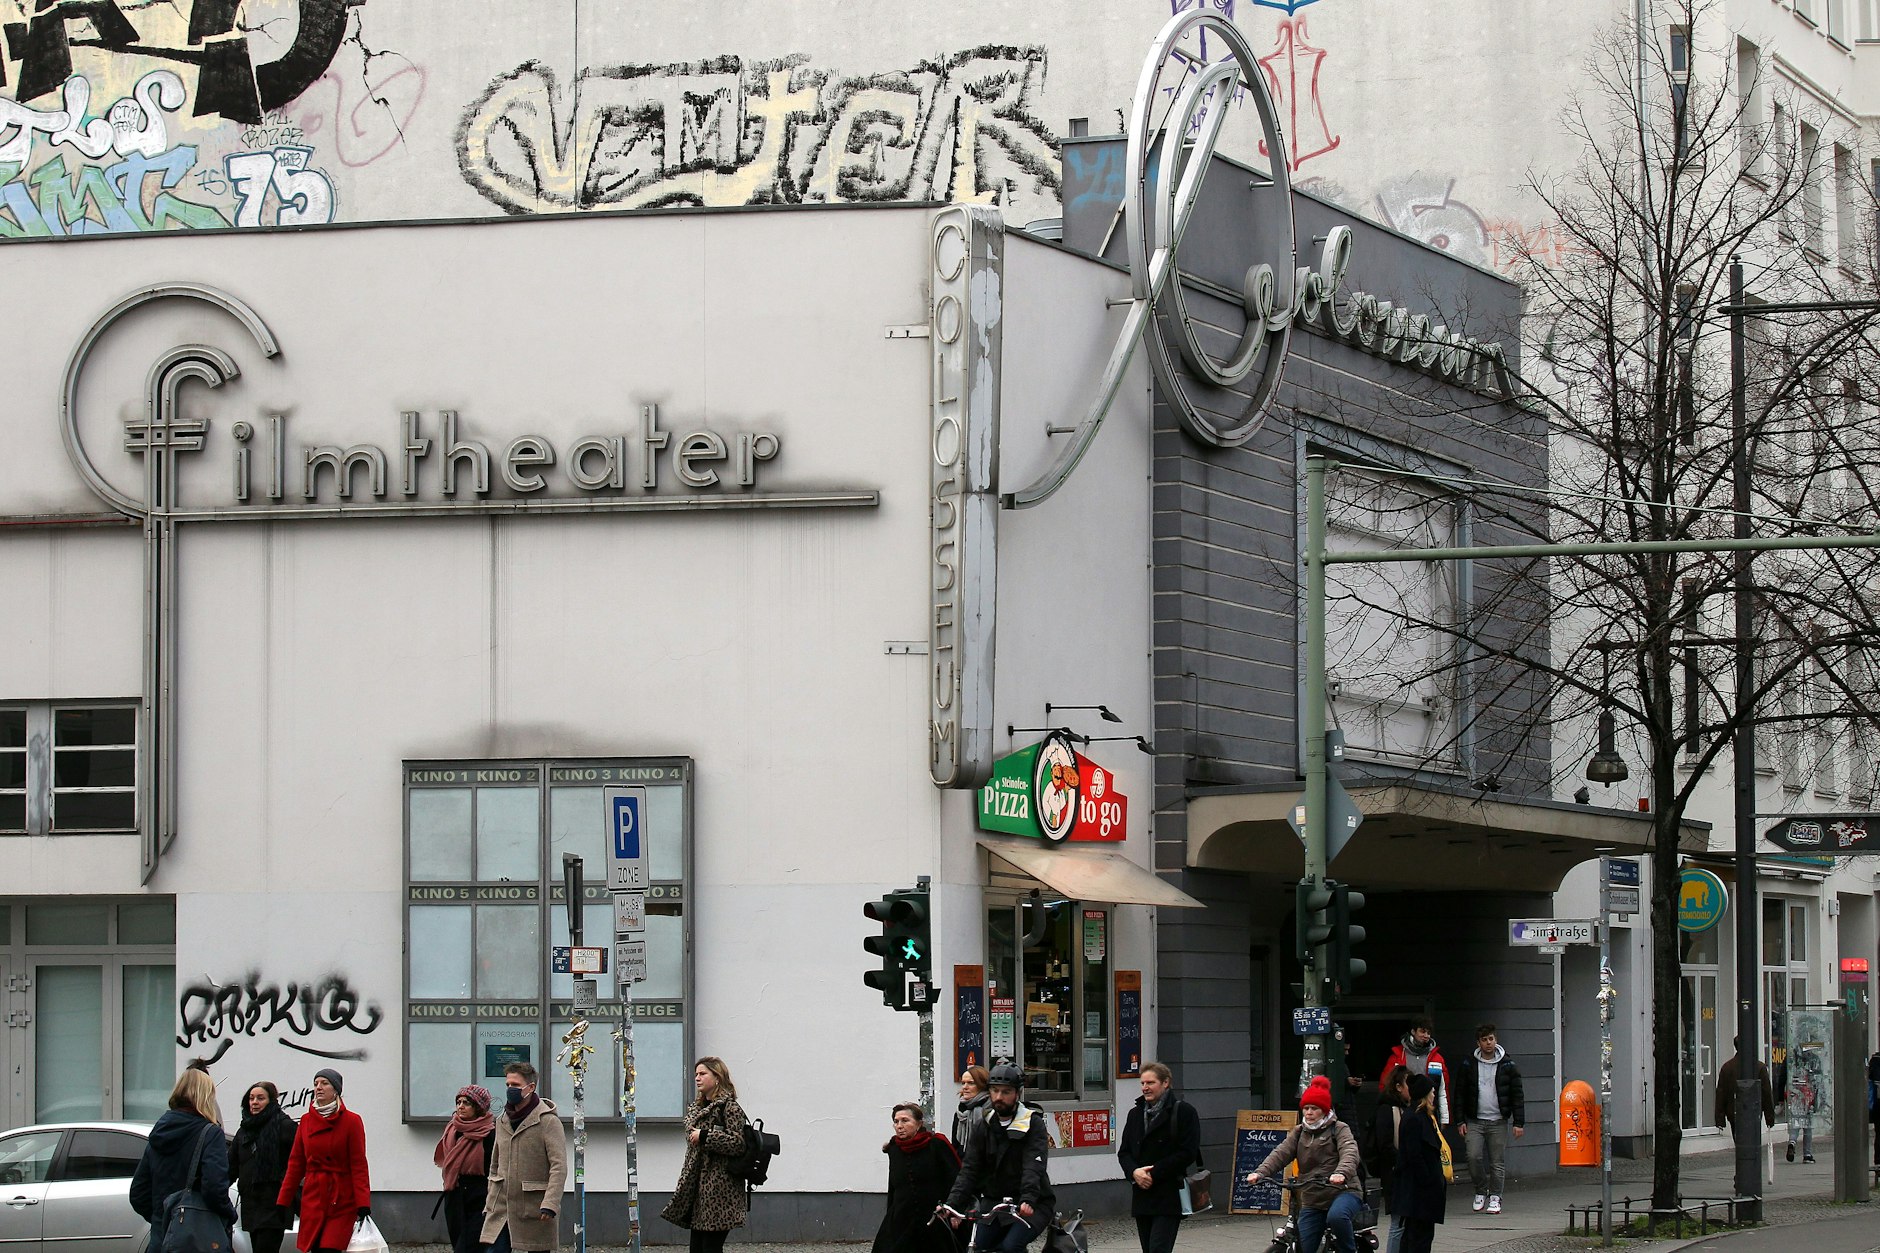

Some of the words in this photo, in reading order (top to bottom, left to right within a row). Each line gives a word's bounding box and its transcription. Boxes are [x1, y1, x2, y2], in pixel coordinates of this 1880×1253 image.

[932, 223, 967, 765] COLOSSEUM
[411, 770, 455, 782] KINO
[461, 771, 468, 781] 1
[477, 770, 521, 782] KINO
[526, 771, 536, 781] 2
[552, 769, 597, 780] KINO
[602, 769, 611, 780] 3
[620, 768, 664, 779] KINO
[670, 768, 680, 779] 4
[983, 780, 1029, 819] Pizza
[1080, 794, 1097, 824] to
[1100, 801, 1121, 837] go
[619, 805, 634, 850] P
[617, 867, 639, 884] ZONE
[411, 888, 455, 899] KINO
[460, 888, 469, 899] 5
[477, 888, 521, 899] KINO
[526, 888, 536, 898] 6
[552, 887, 597, 898] KO
[669, 886, 680, 897] 8
[411, 1005, 455, 1016] KINO
[460, 1005, 469, 1016] 9
[559, 1005, 676, 1016] VRANEIGE
[1702, 1008, 1713, 1019] SALE
[480, 1030, 536, 1038] KINOPROGRAMM
[1251, 1114, 1281, 1122] BIONADE
[1246, 1130, 1277, 1142] Salate
